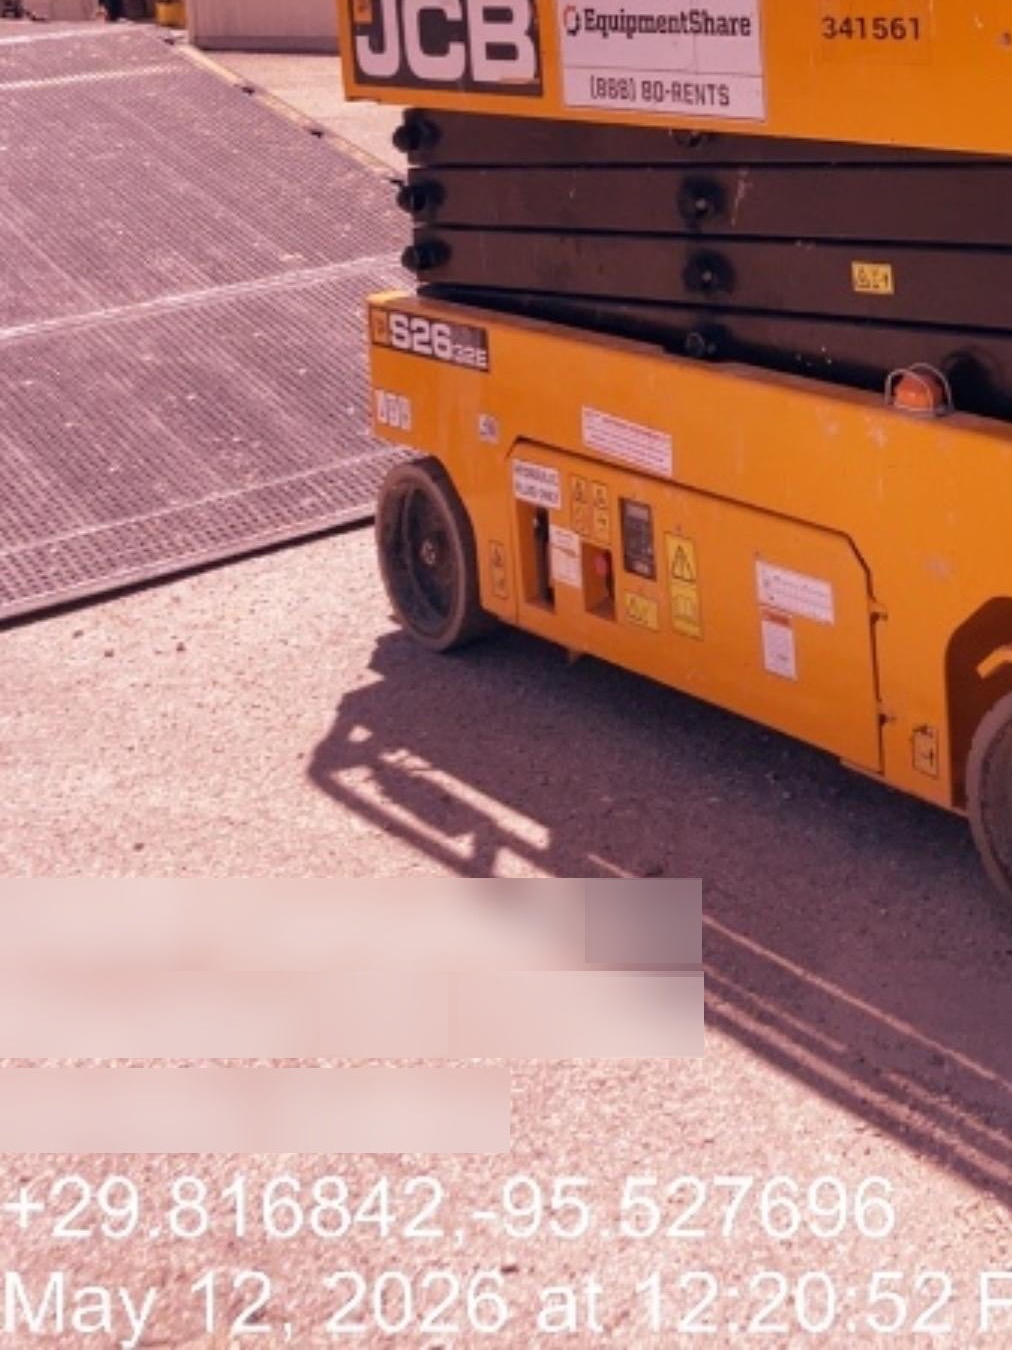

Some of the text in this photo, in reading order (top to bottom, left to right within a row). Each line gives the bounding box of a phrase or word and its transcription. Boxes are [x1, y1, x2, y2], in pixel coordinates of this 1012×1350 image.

[584, 8, 752, 39] EquipmentShare
[822, 16, 920, 41] 341561
[641, 80, 731, 107] 80-RENTS
